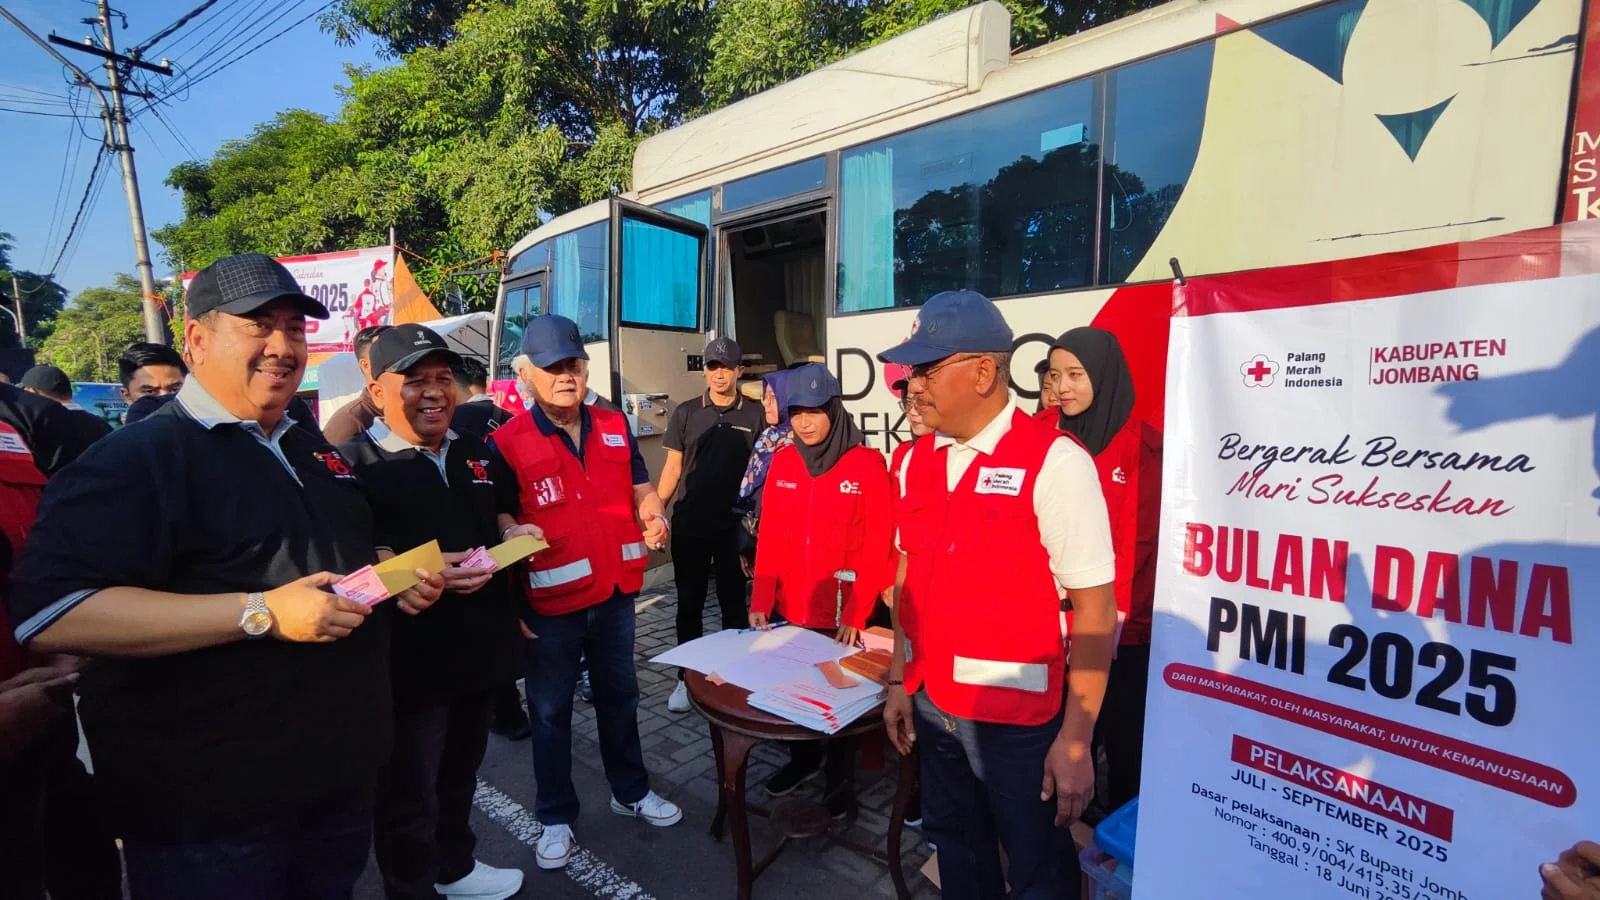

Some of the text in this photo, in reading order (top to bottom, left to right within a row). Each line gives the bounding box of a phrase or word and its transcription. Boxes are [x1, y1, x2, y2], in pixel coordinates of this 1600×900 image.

[1285, 364, 1322, 375] Merah
[1286, 351, 1326, 363] Palang
[1373, 338, 1507, 364] KABUPATEN
[1284, 376, 1343, 388] Indonesia
[1372, 363, 1480, 386] JOMBANG
[1217, 432, 1537, 475] Bergerak Bersama
[1225, 471, 1515, 517] Mari Sukseskan
[1182, 521, 1574, 645] BULAN DANA
[1205, 596, 1518, 727] PMI 2025
[1171, 671, 1564, 795] DARI MASYARAKAT, OLEH MASYARAKAT, UNTUK KEMANUSIAAN
[1250, 744, 1427, 826] PELAKSANAAN
[1191, 782, 1228, 804] Dasar
[1231, 799, 1320, 843] pelaksanaan
[1335, 839, 1355, 858] SK
[1360, 848, 1414, 883] Bupati
[1214, 806, 1258, 832] Nomor
[1231, 768, 1266, 793] JULI
[1282, 786, 1389, 840] SEPTEMBER
[1394, 829, 1449, 863] 2025
[1247, 834, 1298, 868] Tanggal
[1315, 865, 1333, 882] 18
[1337, 875, 1371, 900] Juni
